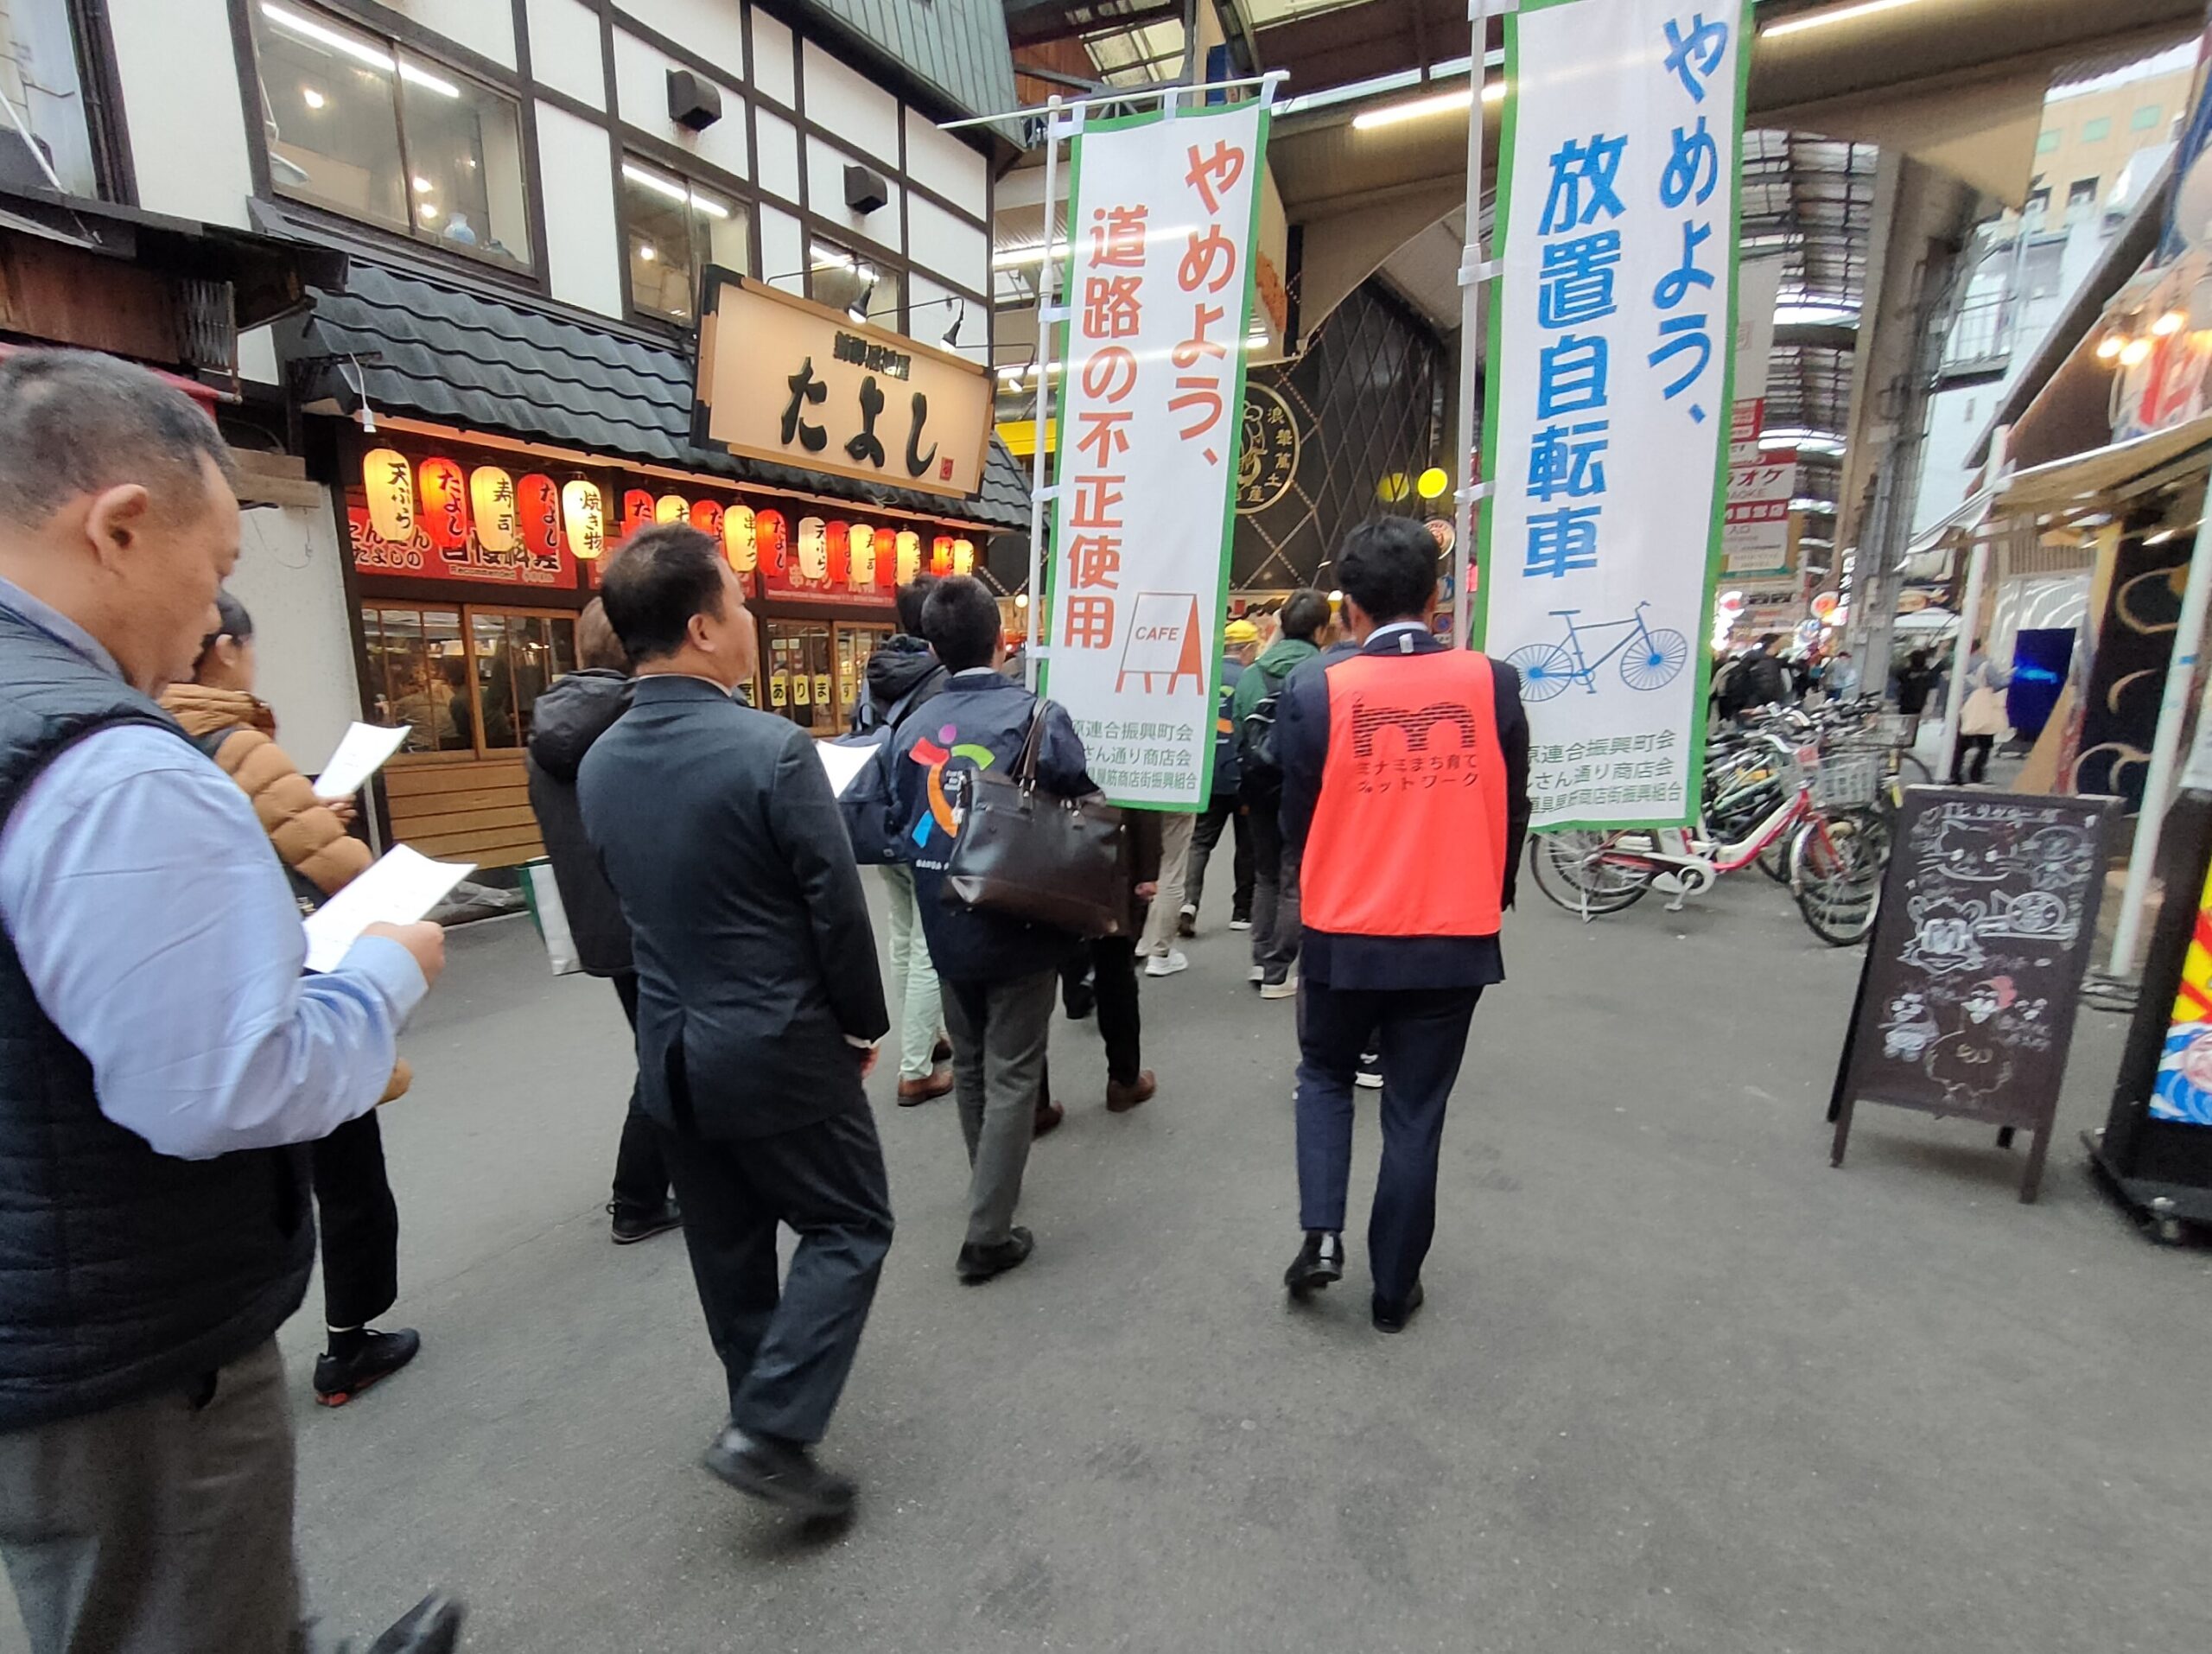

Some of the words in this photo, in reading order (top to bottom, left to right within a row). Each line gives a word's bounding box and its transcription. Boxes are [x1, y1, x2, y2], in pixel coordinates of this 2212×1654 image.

[1648, 12, 1729, 423] やめよう、
[1168, 139, 1244, 466] やめよう、
[1522, 133, 1629, 578] 放置自転車
[781, 356, 938, 477] たよし
[1064, 204, 1148, 649] 道路の不正使用
[387, 462, 411, 529] 天ぷら
[437, 468, 463, 536] たよし
[493, 478, 514, 538] 寿司
[540, 482, 558, 547] たよし
[772, 518, 787, 569] たよし
[1135, 626, 1180, 641] CAFE
